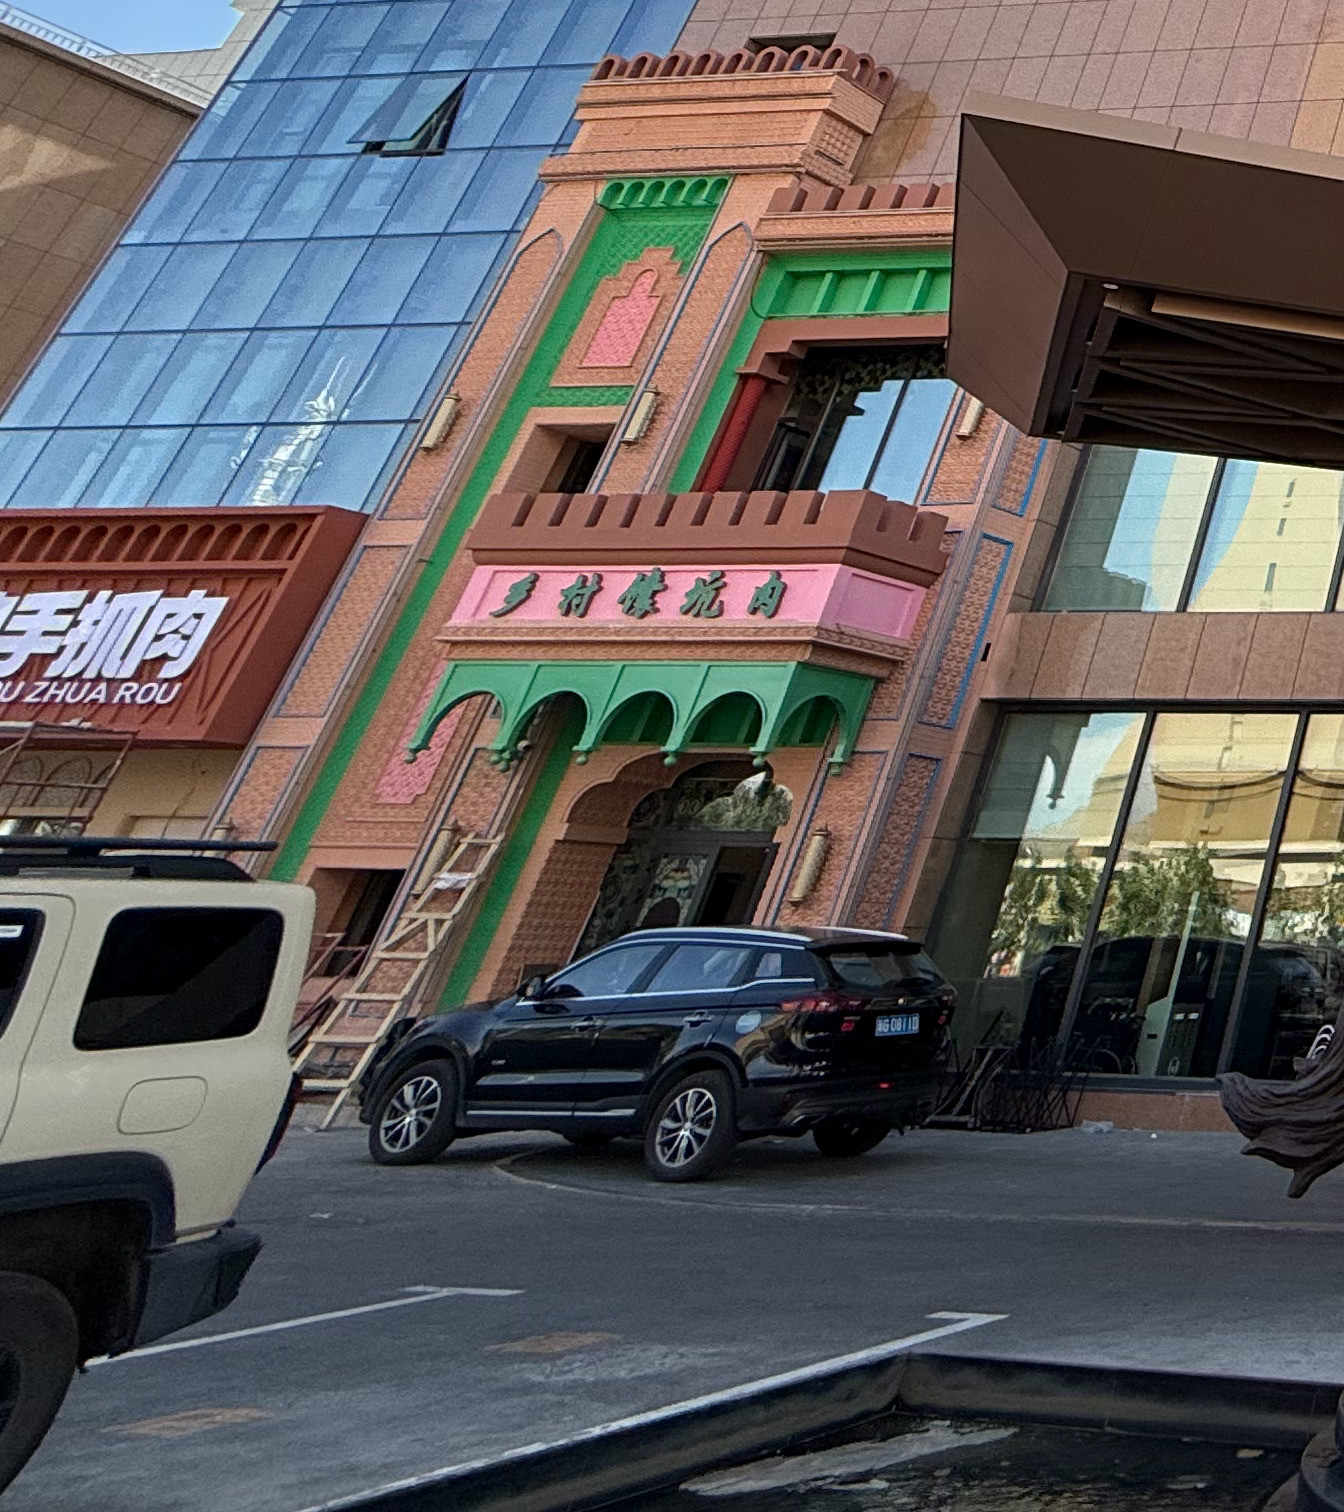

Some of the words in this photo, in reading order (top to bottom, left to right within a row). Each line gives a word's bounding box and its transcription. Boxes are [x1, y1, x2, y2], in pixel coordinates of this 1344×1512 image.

[0, 589, 229, 679] 手抓肉
[24, 681, 107, 703] ZHUA
[112, 682, 182, 704] ROU
